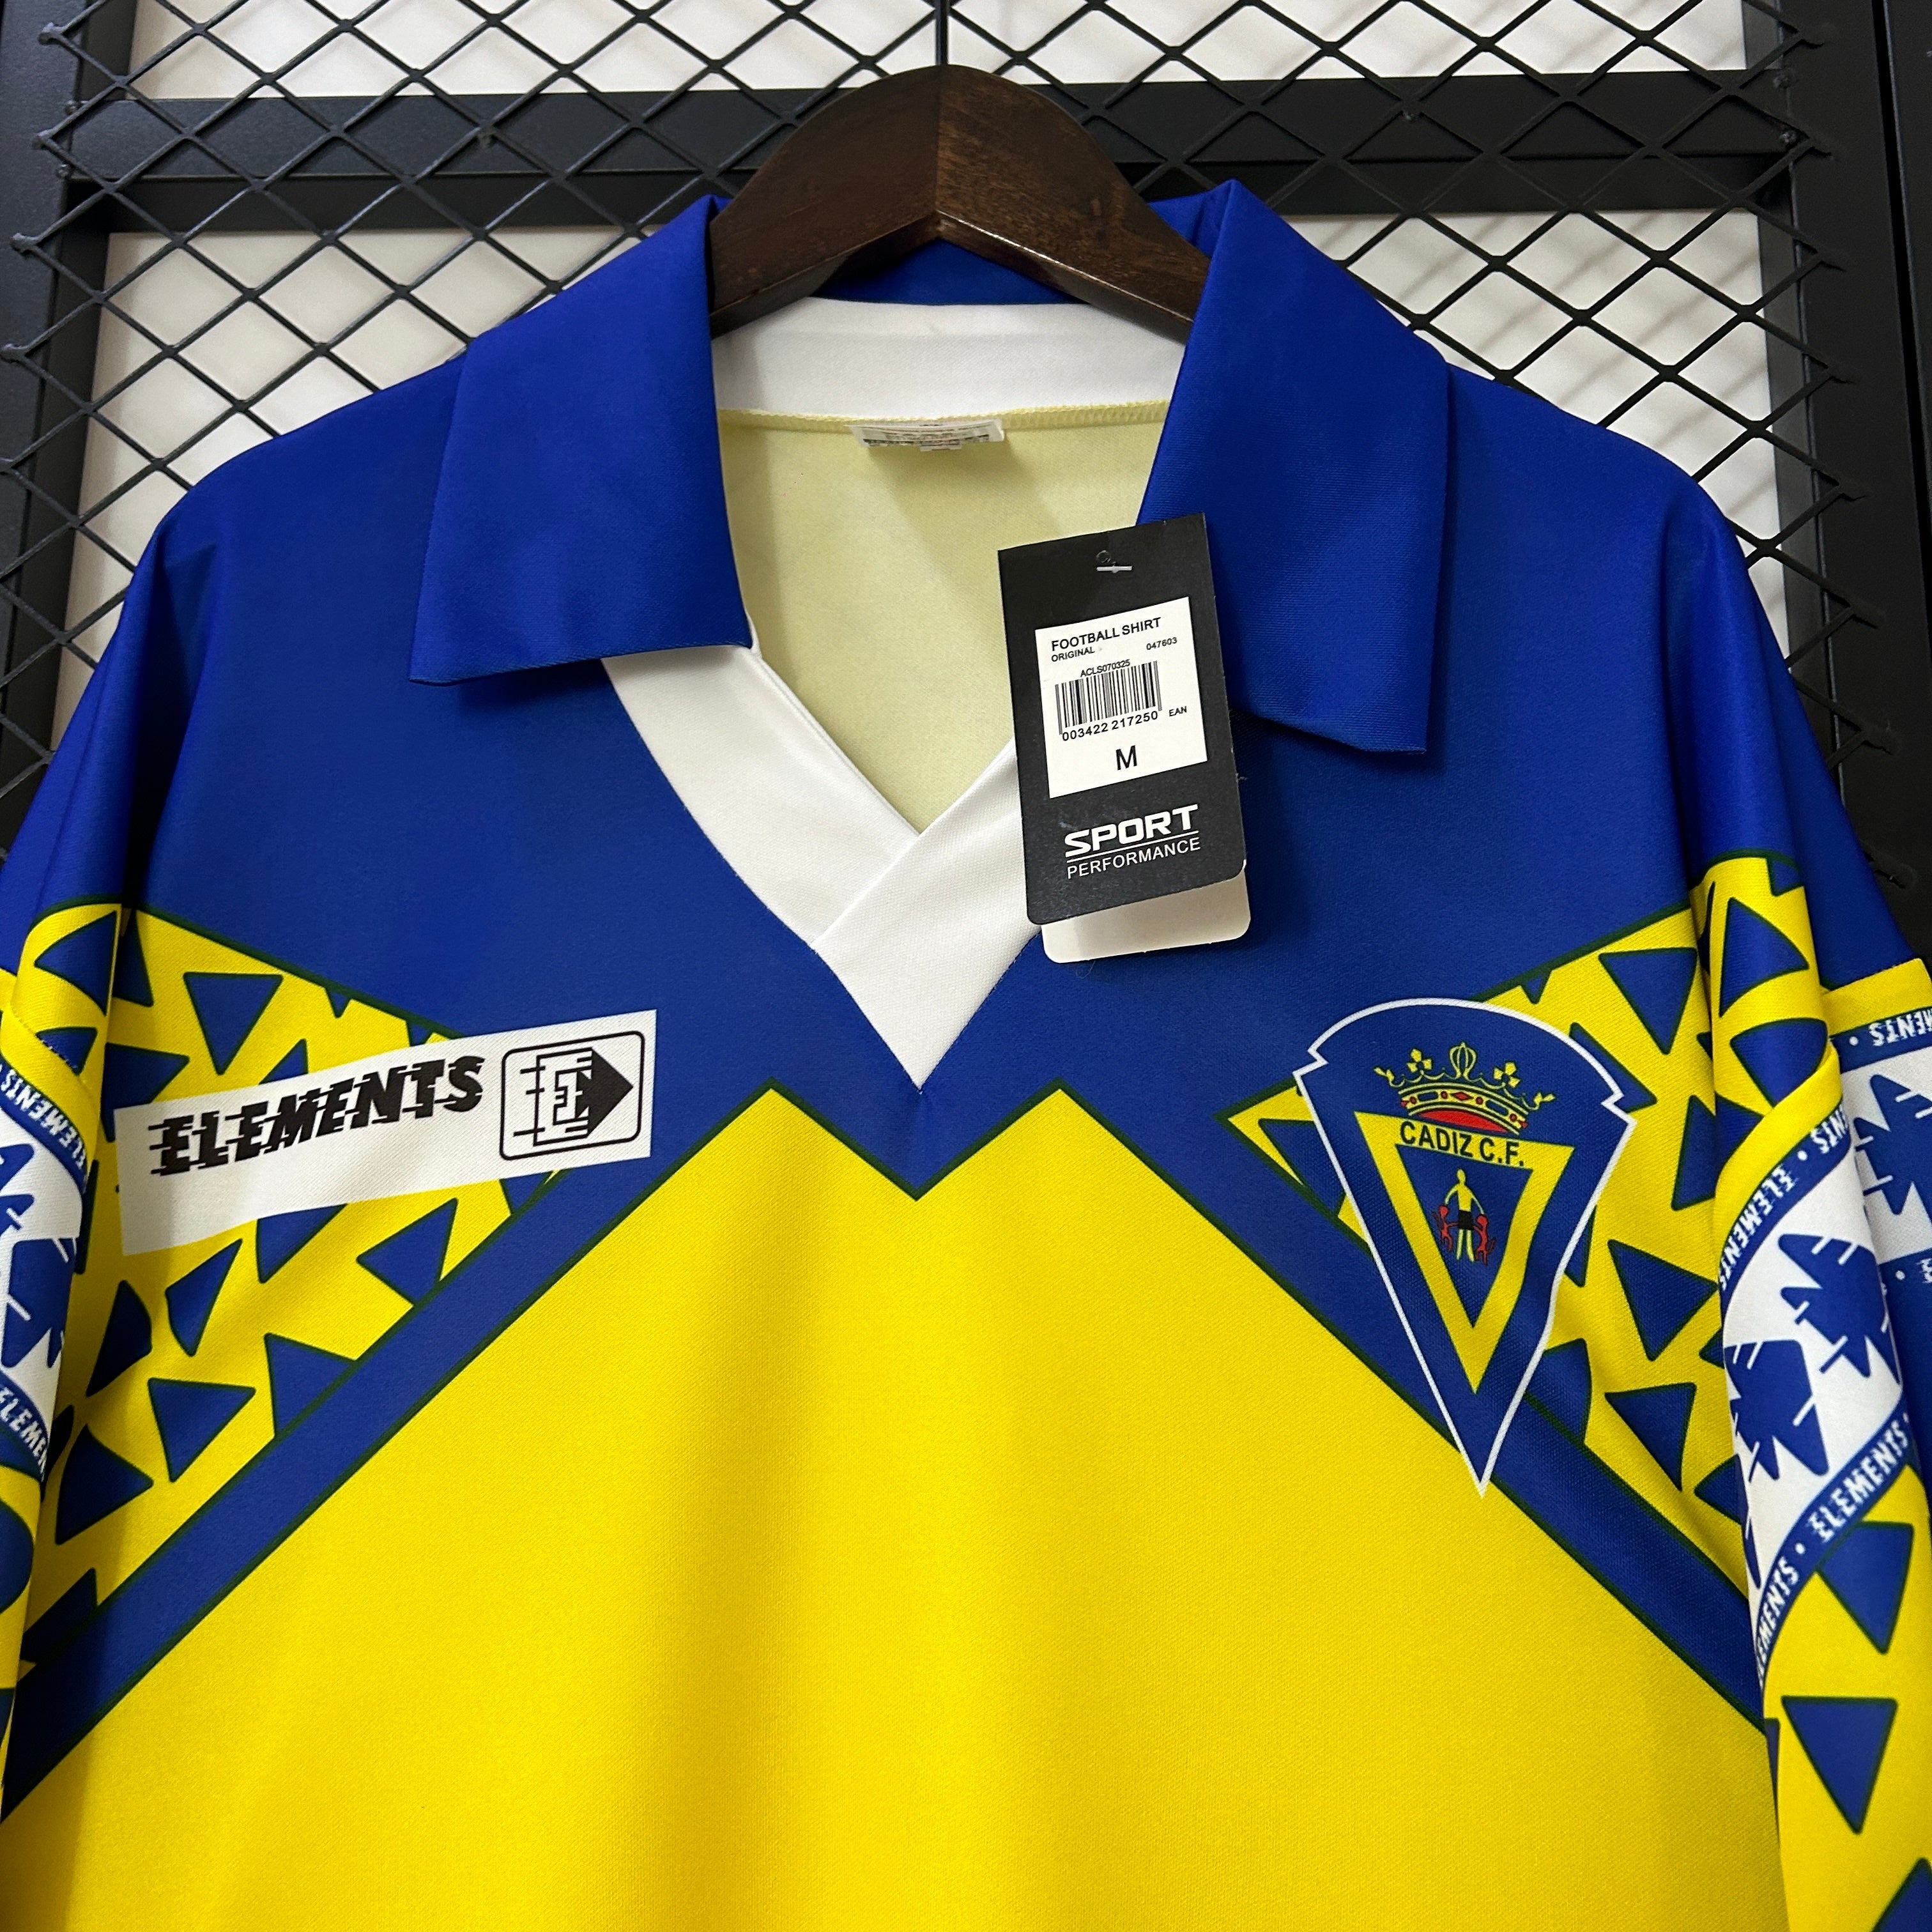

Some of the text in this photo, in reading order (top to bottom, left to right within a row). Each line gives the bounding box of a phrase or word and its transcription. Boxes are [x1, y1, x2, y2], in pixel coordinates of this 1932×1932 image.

[1051, 637, 1177, 662] ORIGINAL 047603
[1052, 617, 1161, 652] FOOTBALL SHIRT
[1080, 659, 1131, 677] ACLS070325
[1062, 710, 1158, 741] 003422 217250
[1169, 706, 1187, 717] EAN
[1116, 745, 1137, 770] M
[1064, 804, 1199, 857] SPORT
[1067, 837, 1201, 879] PERFORMANCE
[148, 1055, 486, 1176] ELEMENTS
[1400, 1121, 1524, 1167] CADIZ C.F.
[1805, 1420, 1908, 1543] ELEMENTS
